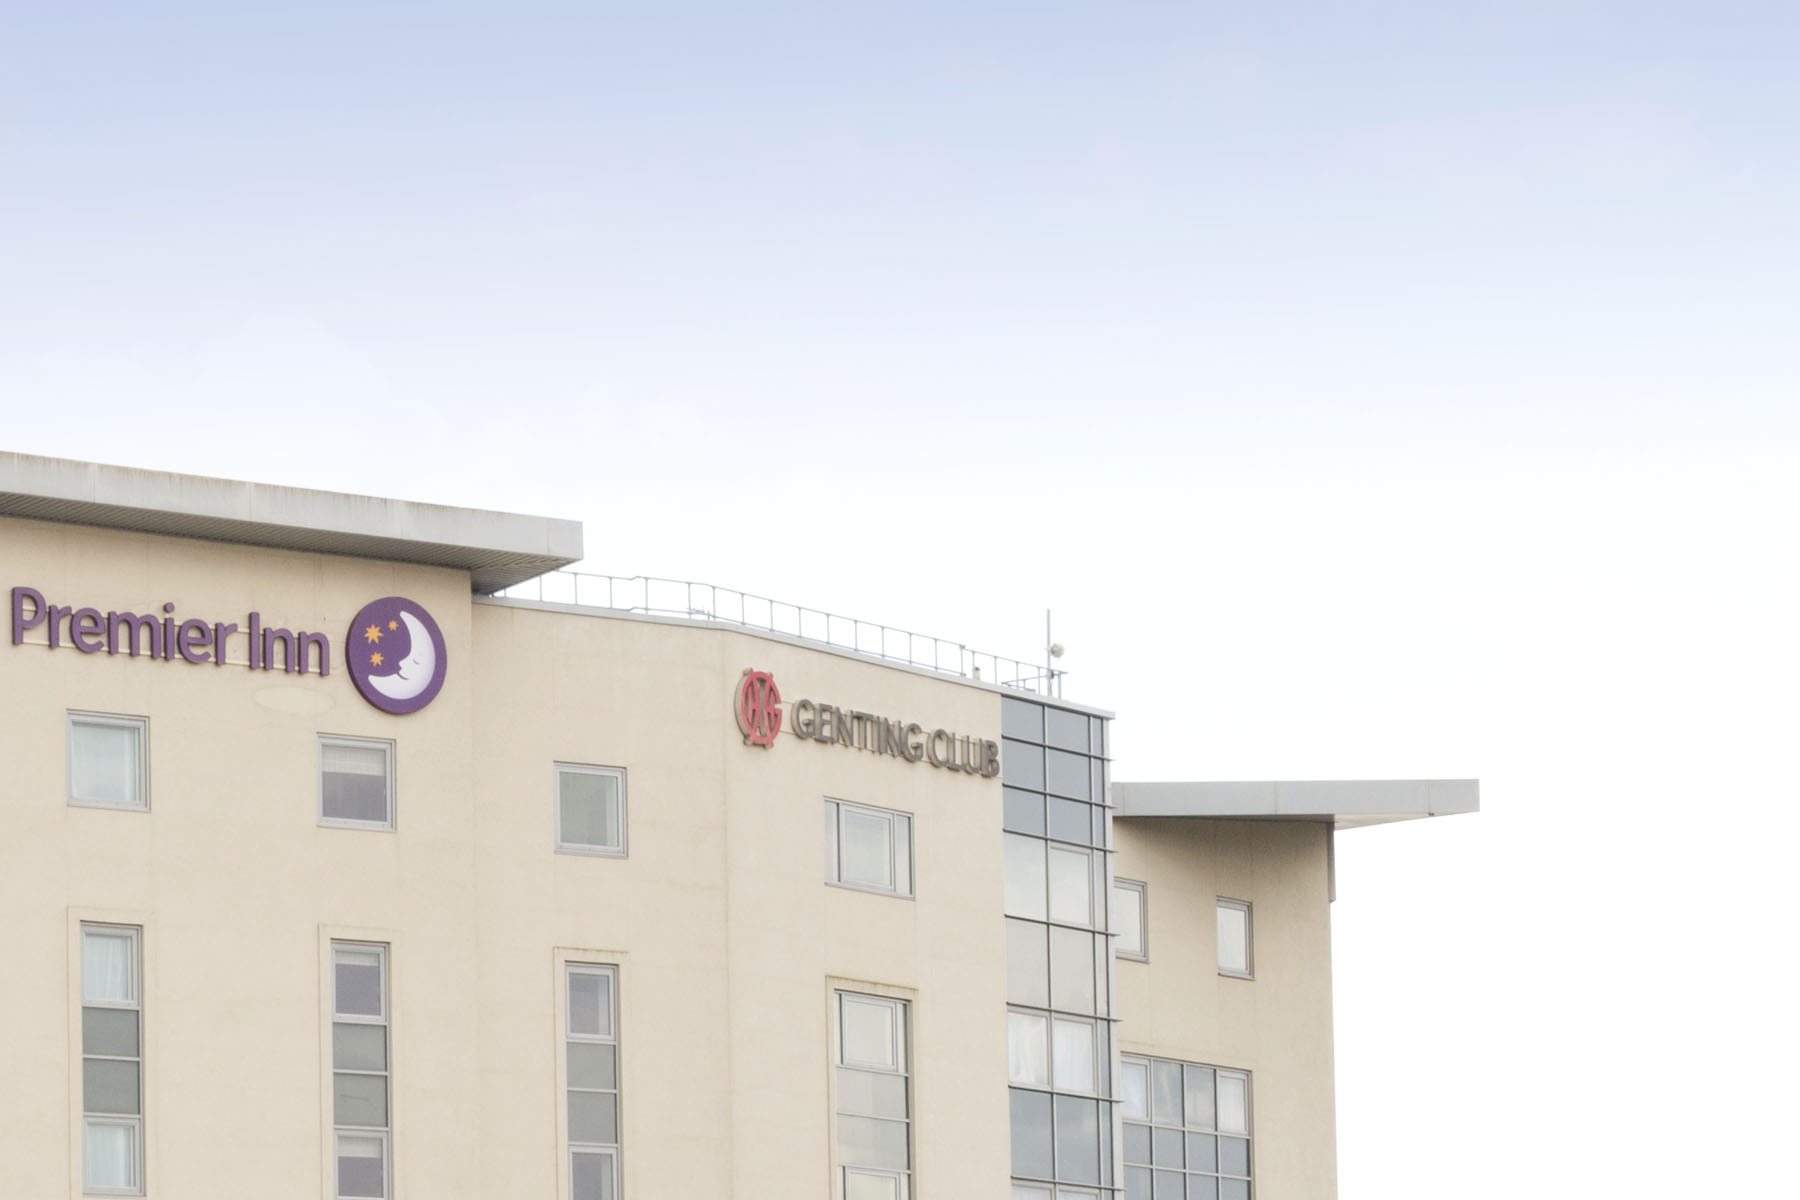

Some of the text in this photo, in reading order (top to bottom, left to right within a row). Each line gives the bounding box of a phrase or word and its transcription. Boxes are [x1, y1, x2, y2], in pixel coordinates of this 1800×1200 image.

[11, 586, 330, 677] Premier Inn
[791, 698, 1000, 778] GENTING CLUB
